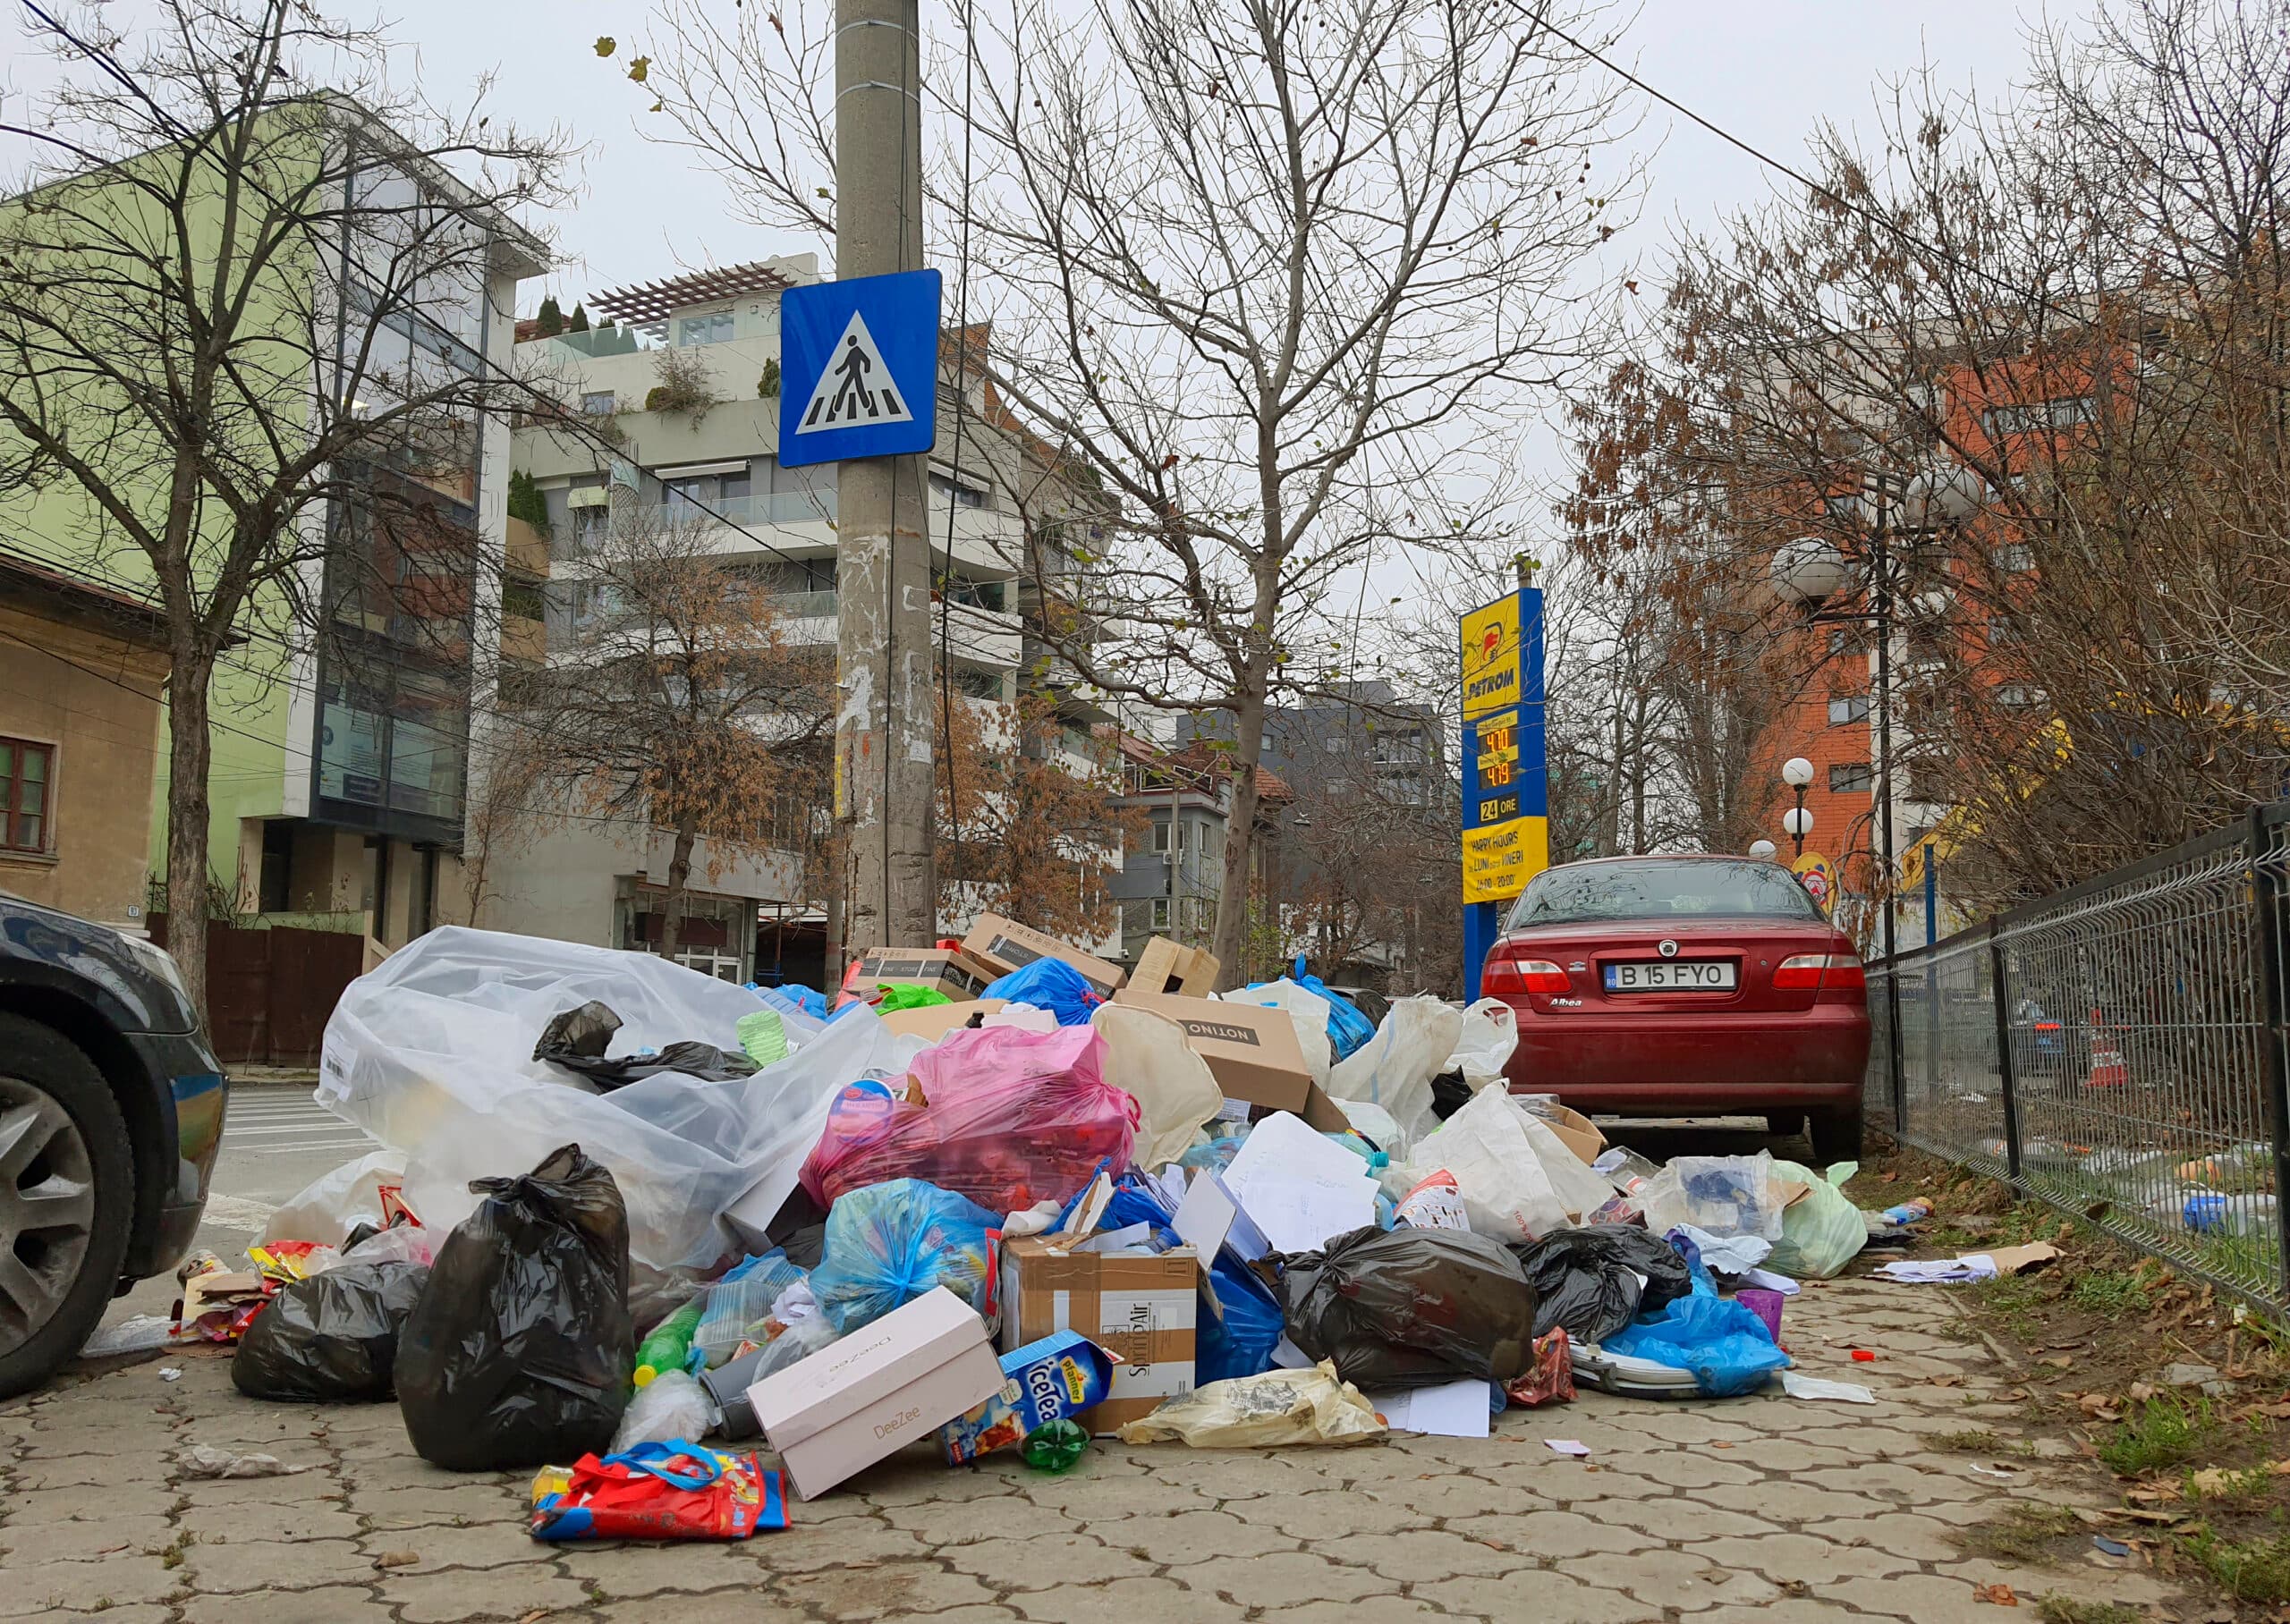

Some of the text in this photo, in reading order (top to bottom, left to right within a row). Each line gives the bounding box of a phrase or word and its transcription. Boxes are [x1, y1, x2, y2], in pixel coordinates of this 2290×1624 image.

[1469, 668, 1514, 698] PETROM
[1482, 799, 1516, 820] 24 ORE
[1472, 831, 1519, 853] HAPPY HOURS
[1474, 856, 1489, 872] LUNI
[1622, 966, 1722, 985] B 15 FYO
[1549, 998, 1582, 1008] Albea
[1189, 1024, 1249, 1040] NOTINO
[1063, 1358, 1080, 1401] pfanner
[873, 1407, 921, 1440] DeeZee
